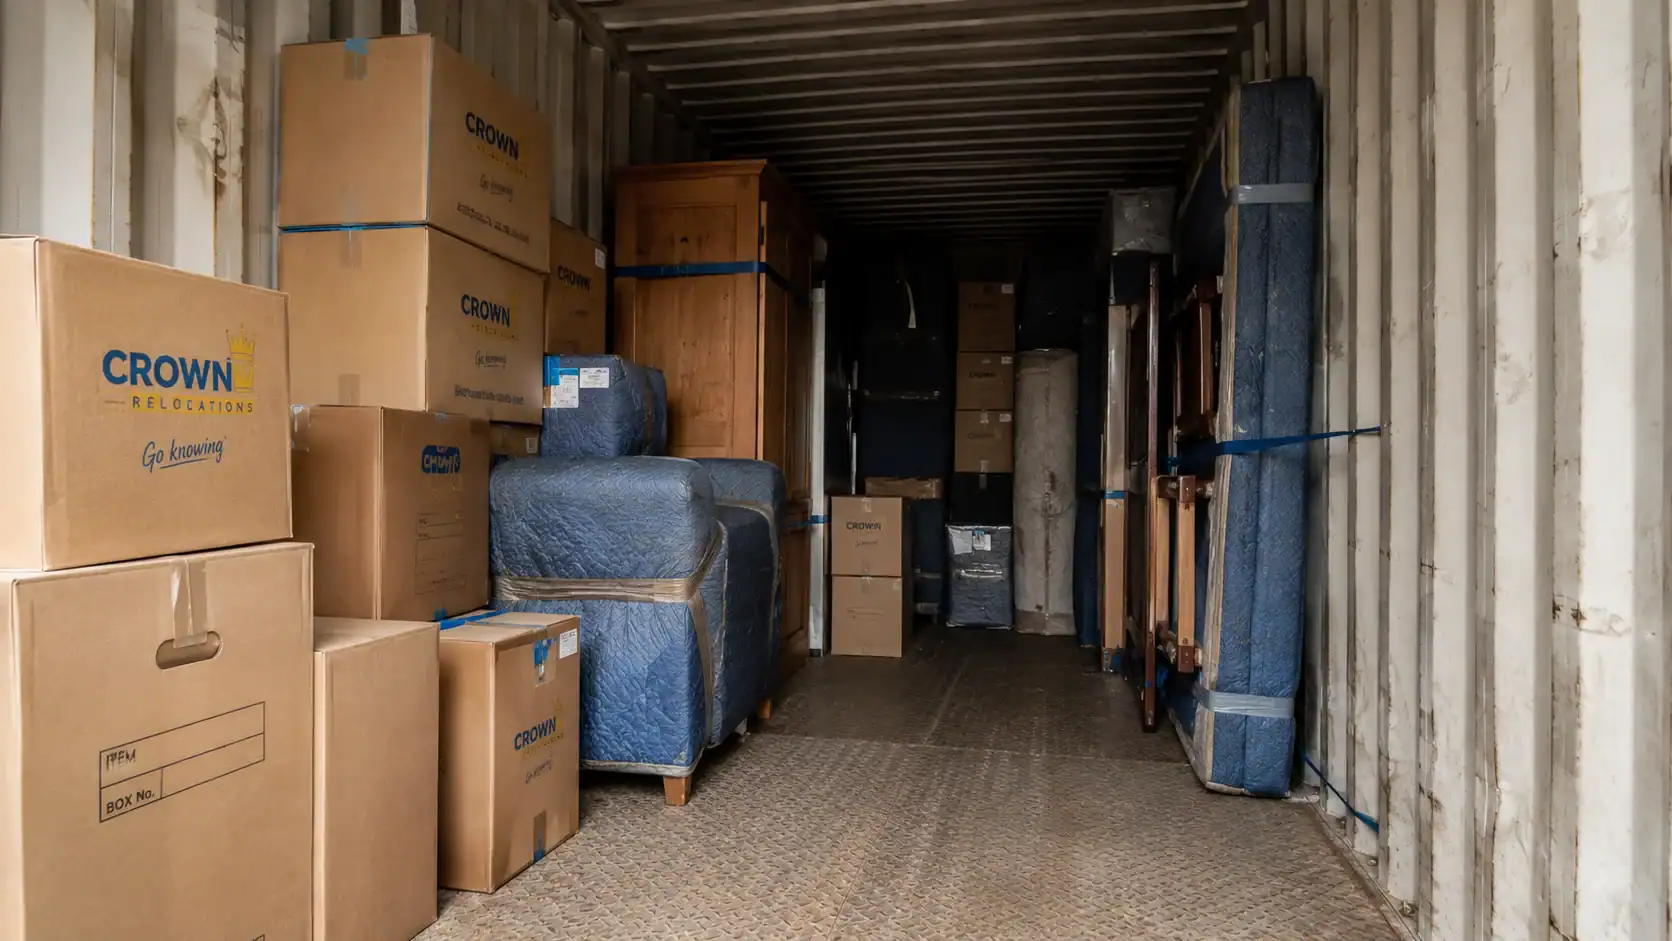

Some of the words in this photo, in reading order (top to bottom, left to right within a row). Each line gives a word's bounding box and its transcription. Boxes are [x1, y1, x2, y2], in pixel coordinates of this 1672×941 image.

[465, 111, 519, 161] CROWN
[461, 293, 511, 328] CROWN
[102, 349, 232, 392] CROWN
[132, 395, 253, 413] RELOCATIONS
[142, 440, 164, 473] Go
[169, 438, 224, 464] knowing
[514, 716, 556, 750] CROWN
[106, 793, 132, 814] BOX
[136, 789, 155, 803] No.
